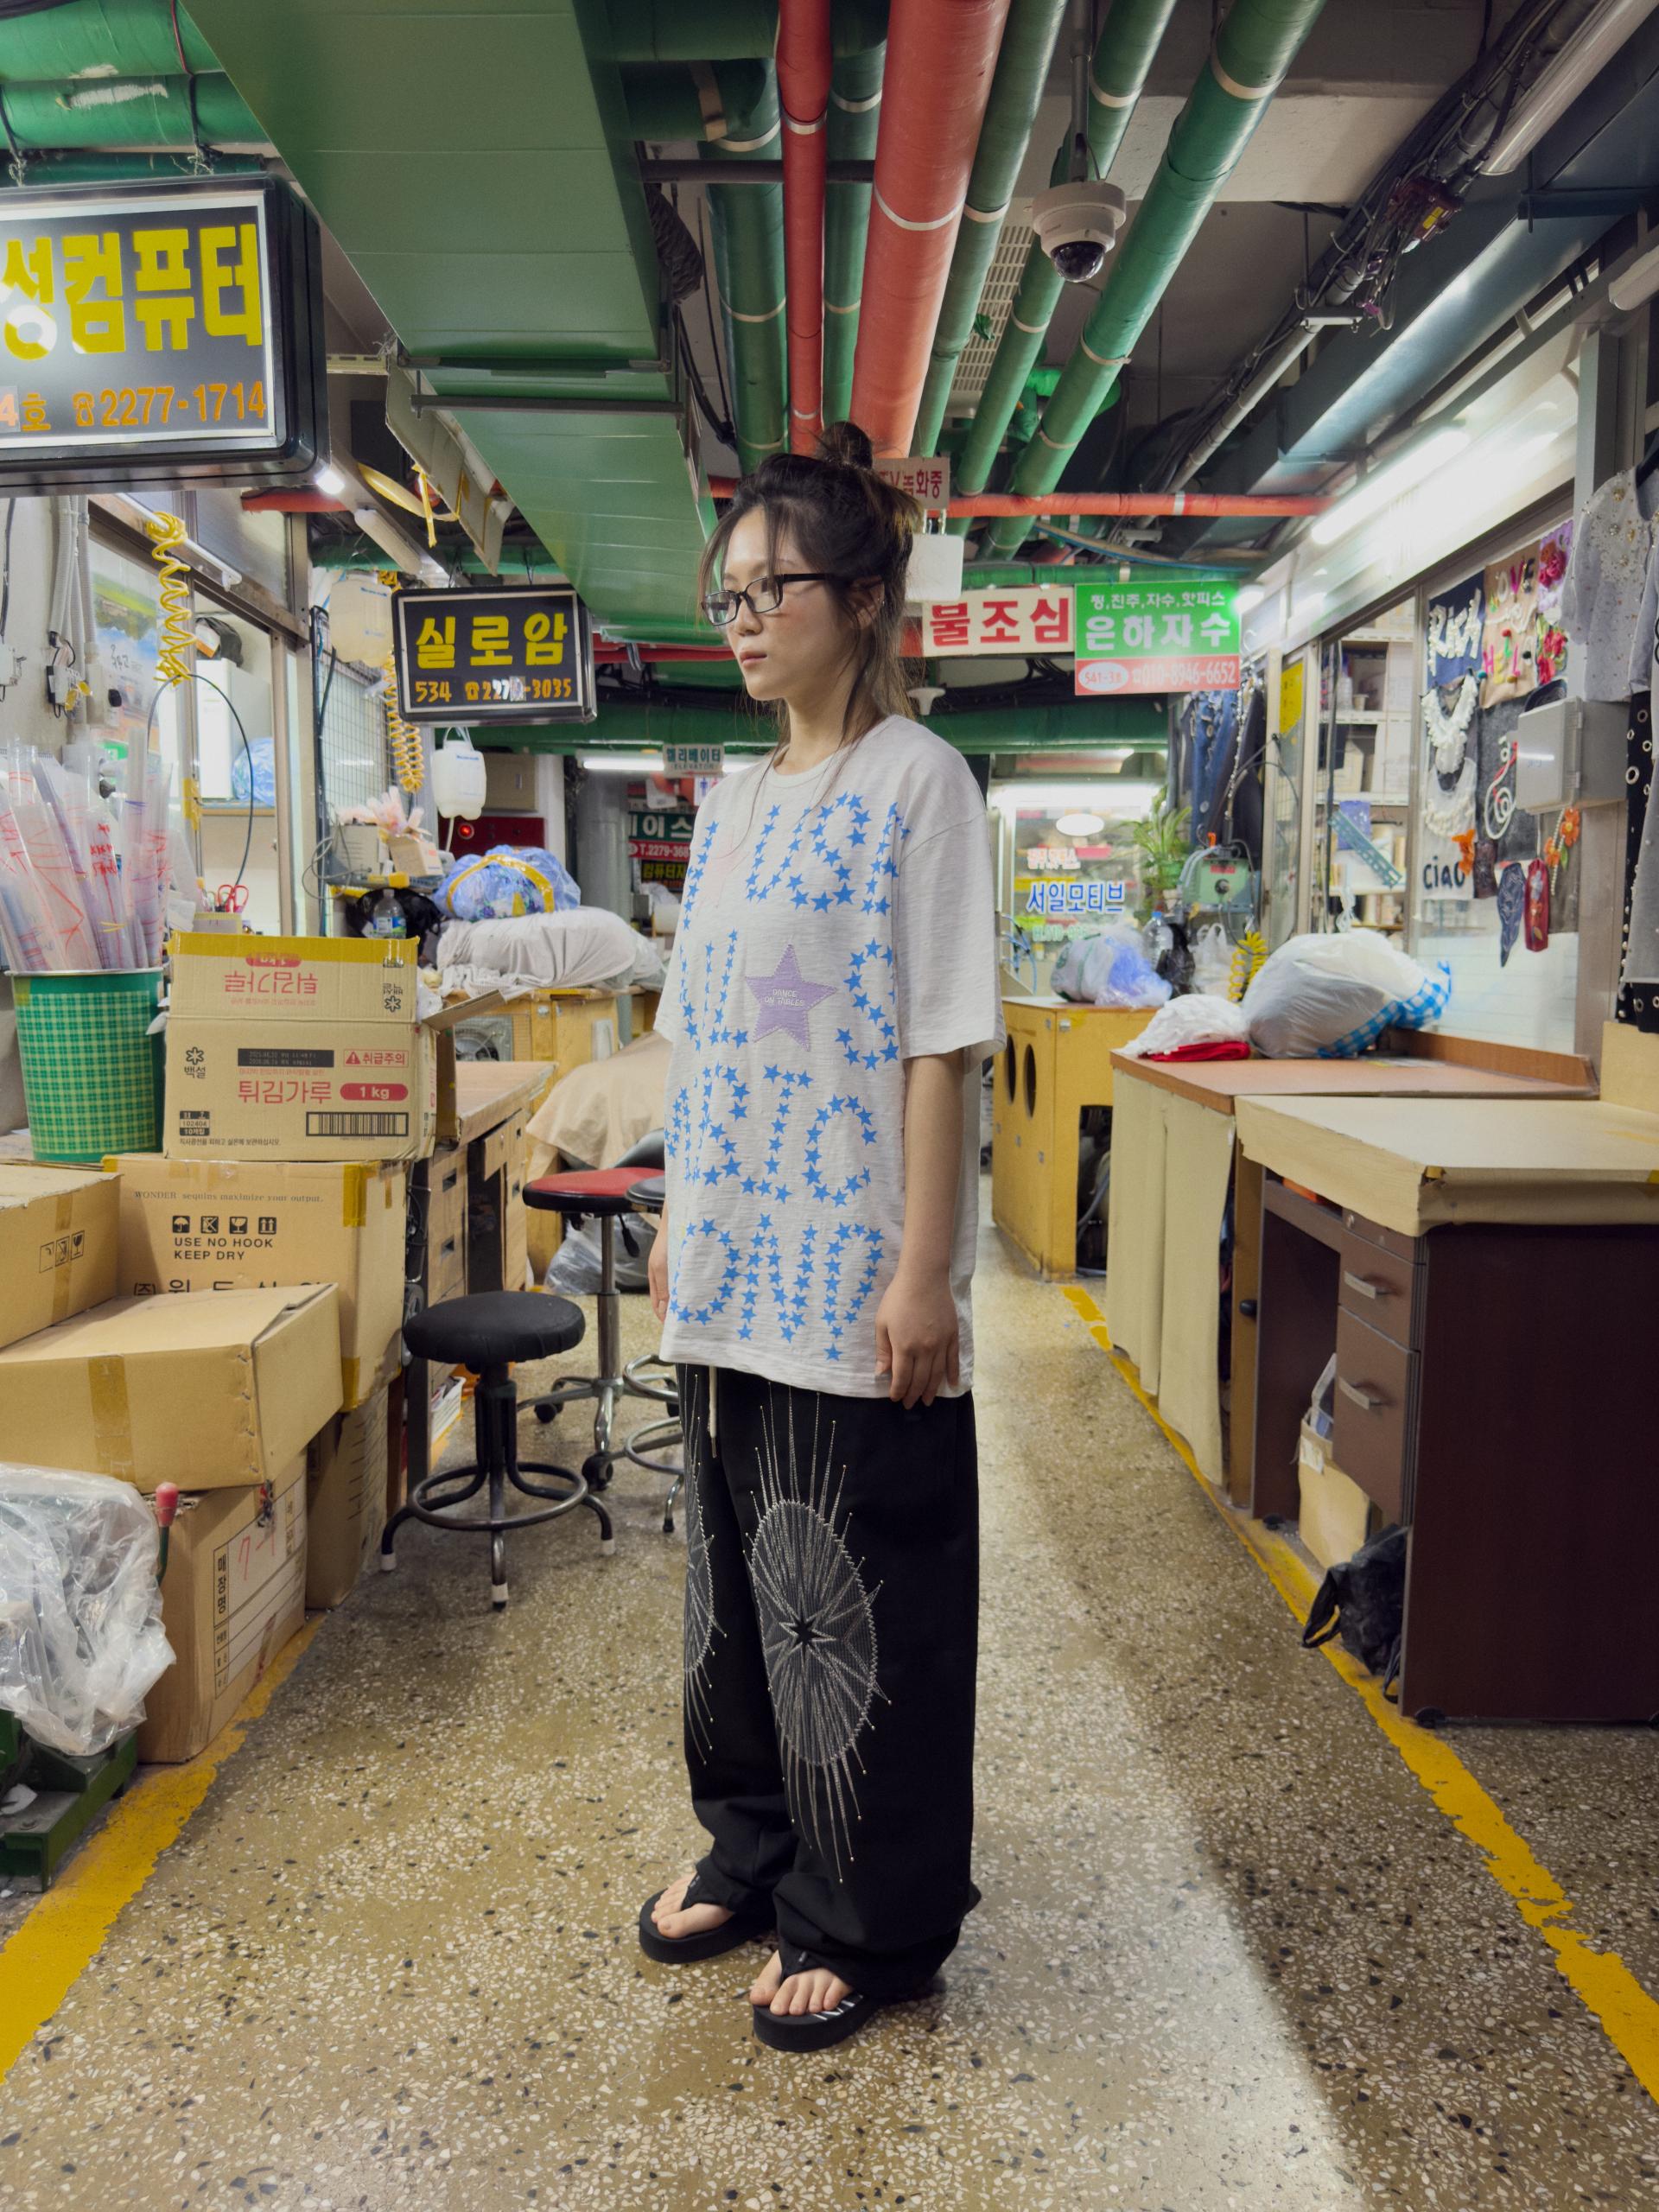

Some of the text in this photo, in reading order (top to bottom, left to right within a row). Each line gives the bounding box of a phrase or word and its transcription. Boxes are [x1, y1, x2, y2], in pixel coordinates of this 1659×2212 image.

[2, 223, 263, 360] 성컴퓨터
[100, 381, 266, 427] 2277-1714
[930, 598, 1069, 646] 불조심
[1085, 612, 1231, 651] 은하자수
[416, 613, 568, 669] 실로암
[415, 680, 452, 702] 534
[640, 843, 690, 858] T.2279-368
[1027, 882, 1123, 912] 서일모티브
[225, 970, 318, 995] 튀김가루
[383, 982, 404, 995] 백설
[772, 988, 798, 998] DANCE
[776, 997, 804, 1007] TABLES
[362, 1051, 406, 1065] 취급주의
[184, 1065, 206, 1079] 백설
[238, 1080, 390, 1104] 튀김가루 1 kg
[134, 1191, 177, 1199] WONDER
[182, 1192, 217, 1201] sequins
[220, 1192, 264, 1201] maximize
[290, 1194, 325, 1204] output.
[175, 1237, 273, 1248] USE NO HOOK
[175, 1250, 246, 1261] KEEP DRY
